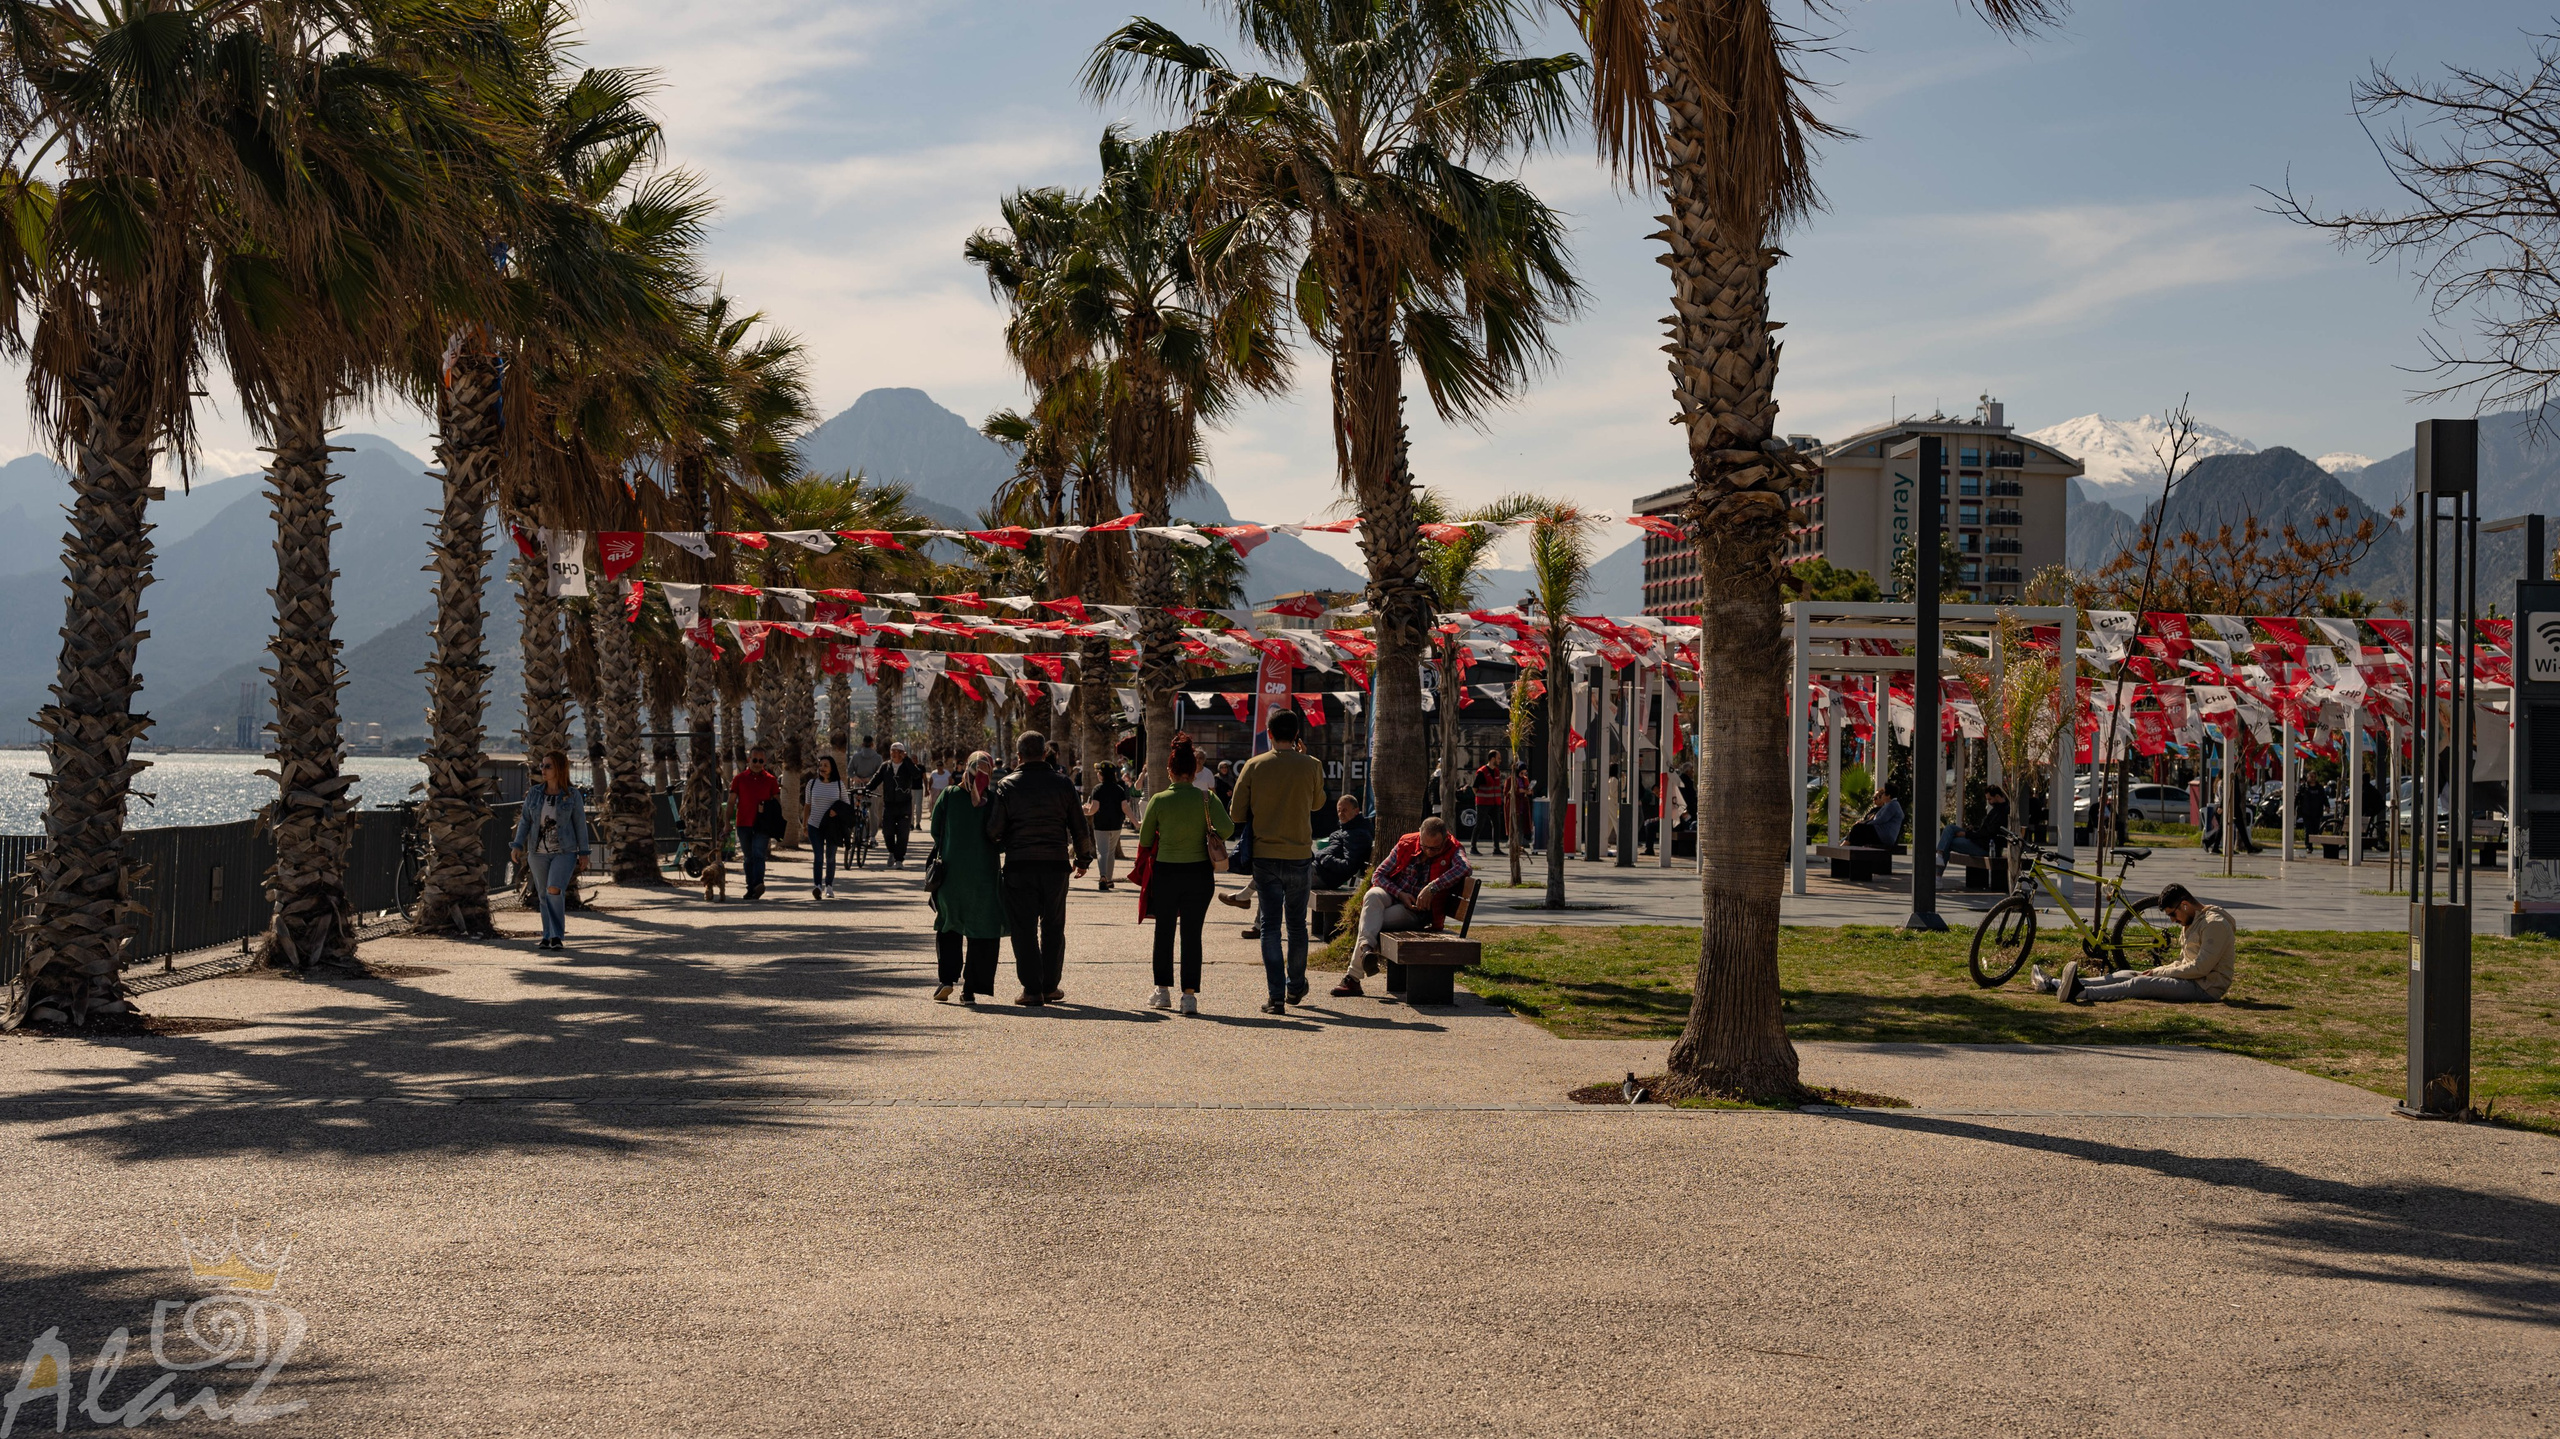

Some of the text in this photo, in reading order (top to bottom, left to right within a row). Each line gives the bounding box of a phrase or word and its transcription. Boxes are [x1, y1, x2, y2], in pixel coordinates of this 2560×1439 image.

[2100, 616, 2127, 628] CHP
[835, 652, 853, 661] CHP
[1265, 681, 1287, 694] CHP
[2205, 695, 2228, 704] CHP
